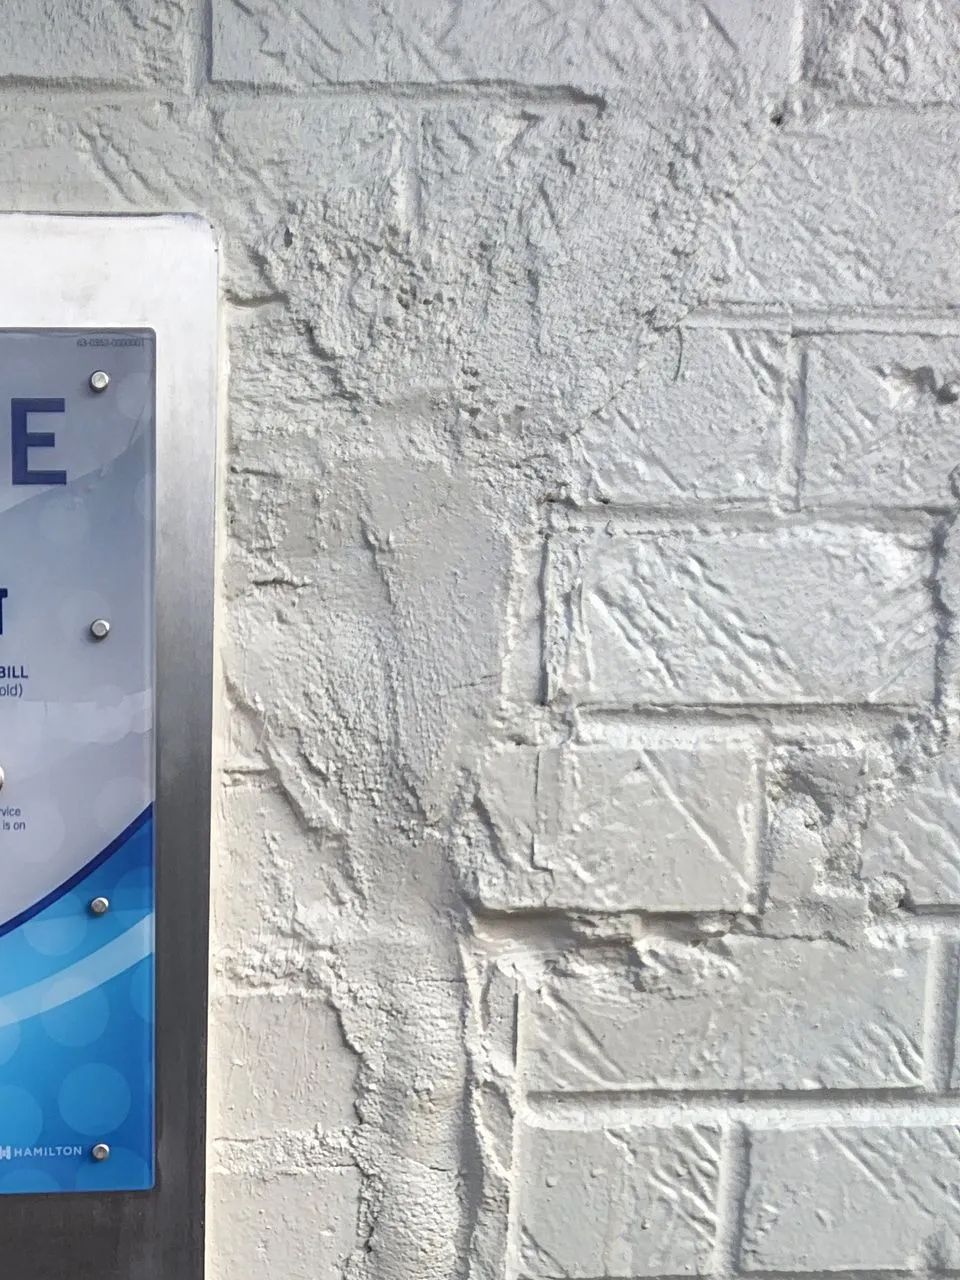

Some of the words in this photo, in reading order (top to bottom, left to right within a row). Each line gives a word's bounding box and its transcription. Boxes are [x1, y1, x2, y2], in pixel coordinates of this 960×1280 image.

[3, 819, 11, 831] is
[13, 820, 26, 831] on
[13, 1146, 83, 1158] HAMILTON
